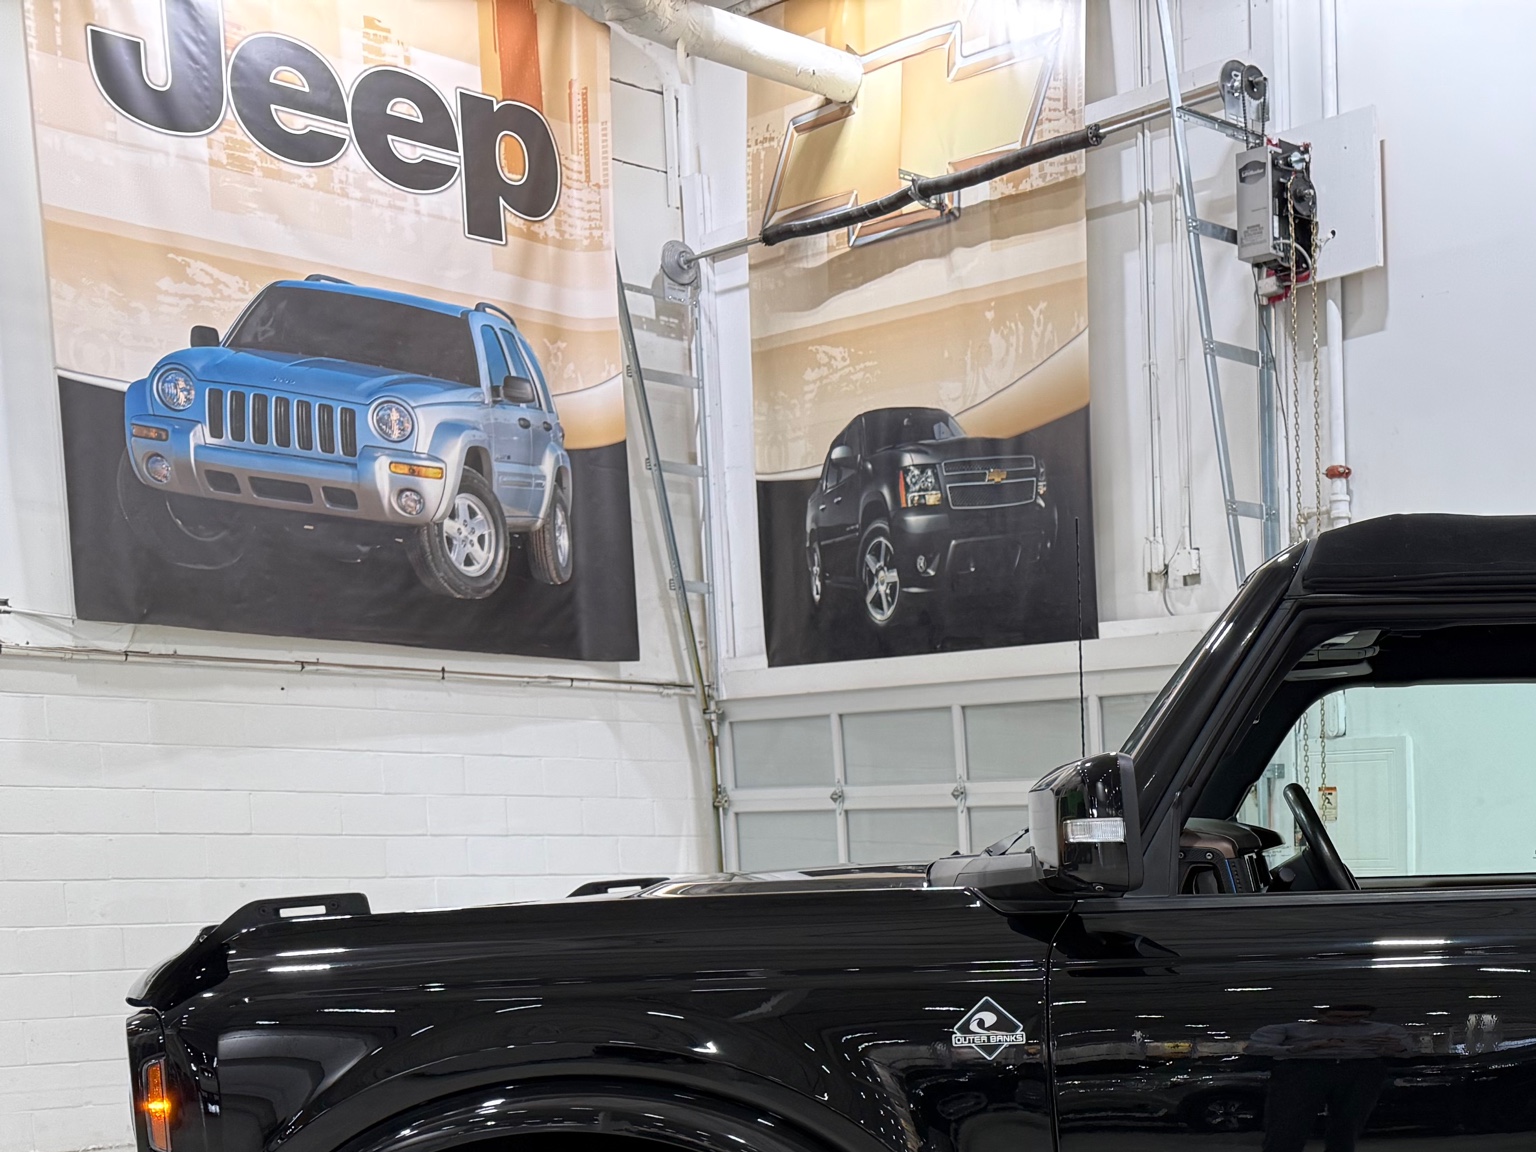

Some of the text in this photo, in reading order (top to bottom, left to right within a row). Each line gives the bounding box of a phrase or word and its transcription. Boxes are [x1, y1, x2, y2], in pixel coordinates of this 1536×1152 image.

[86, 0, 562, 245] Jeep
[955, 1034, 1022, 1044] OUTER BANKS
